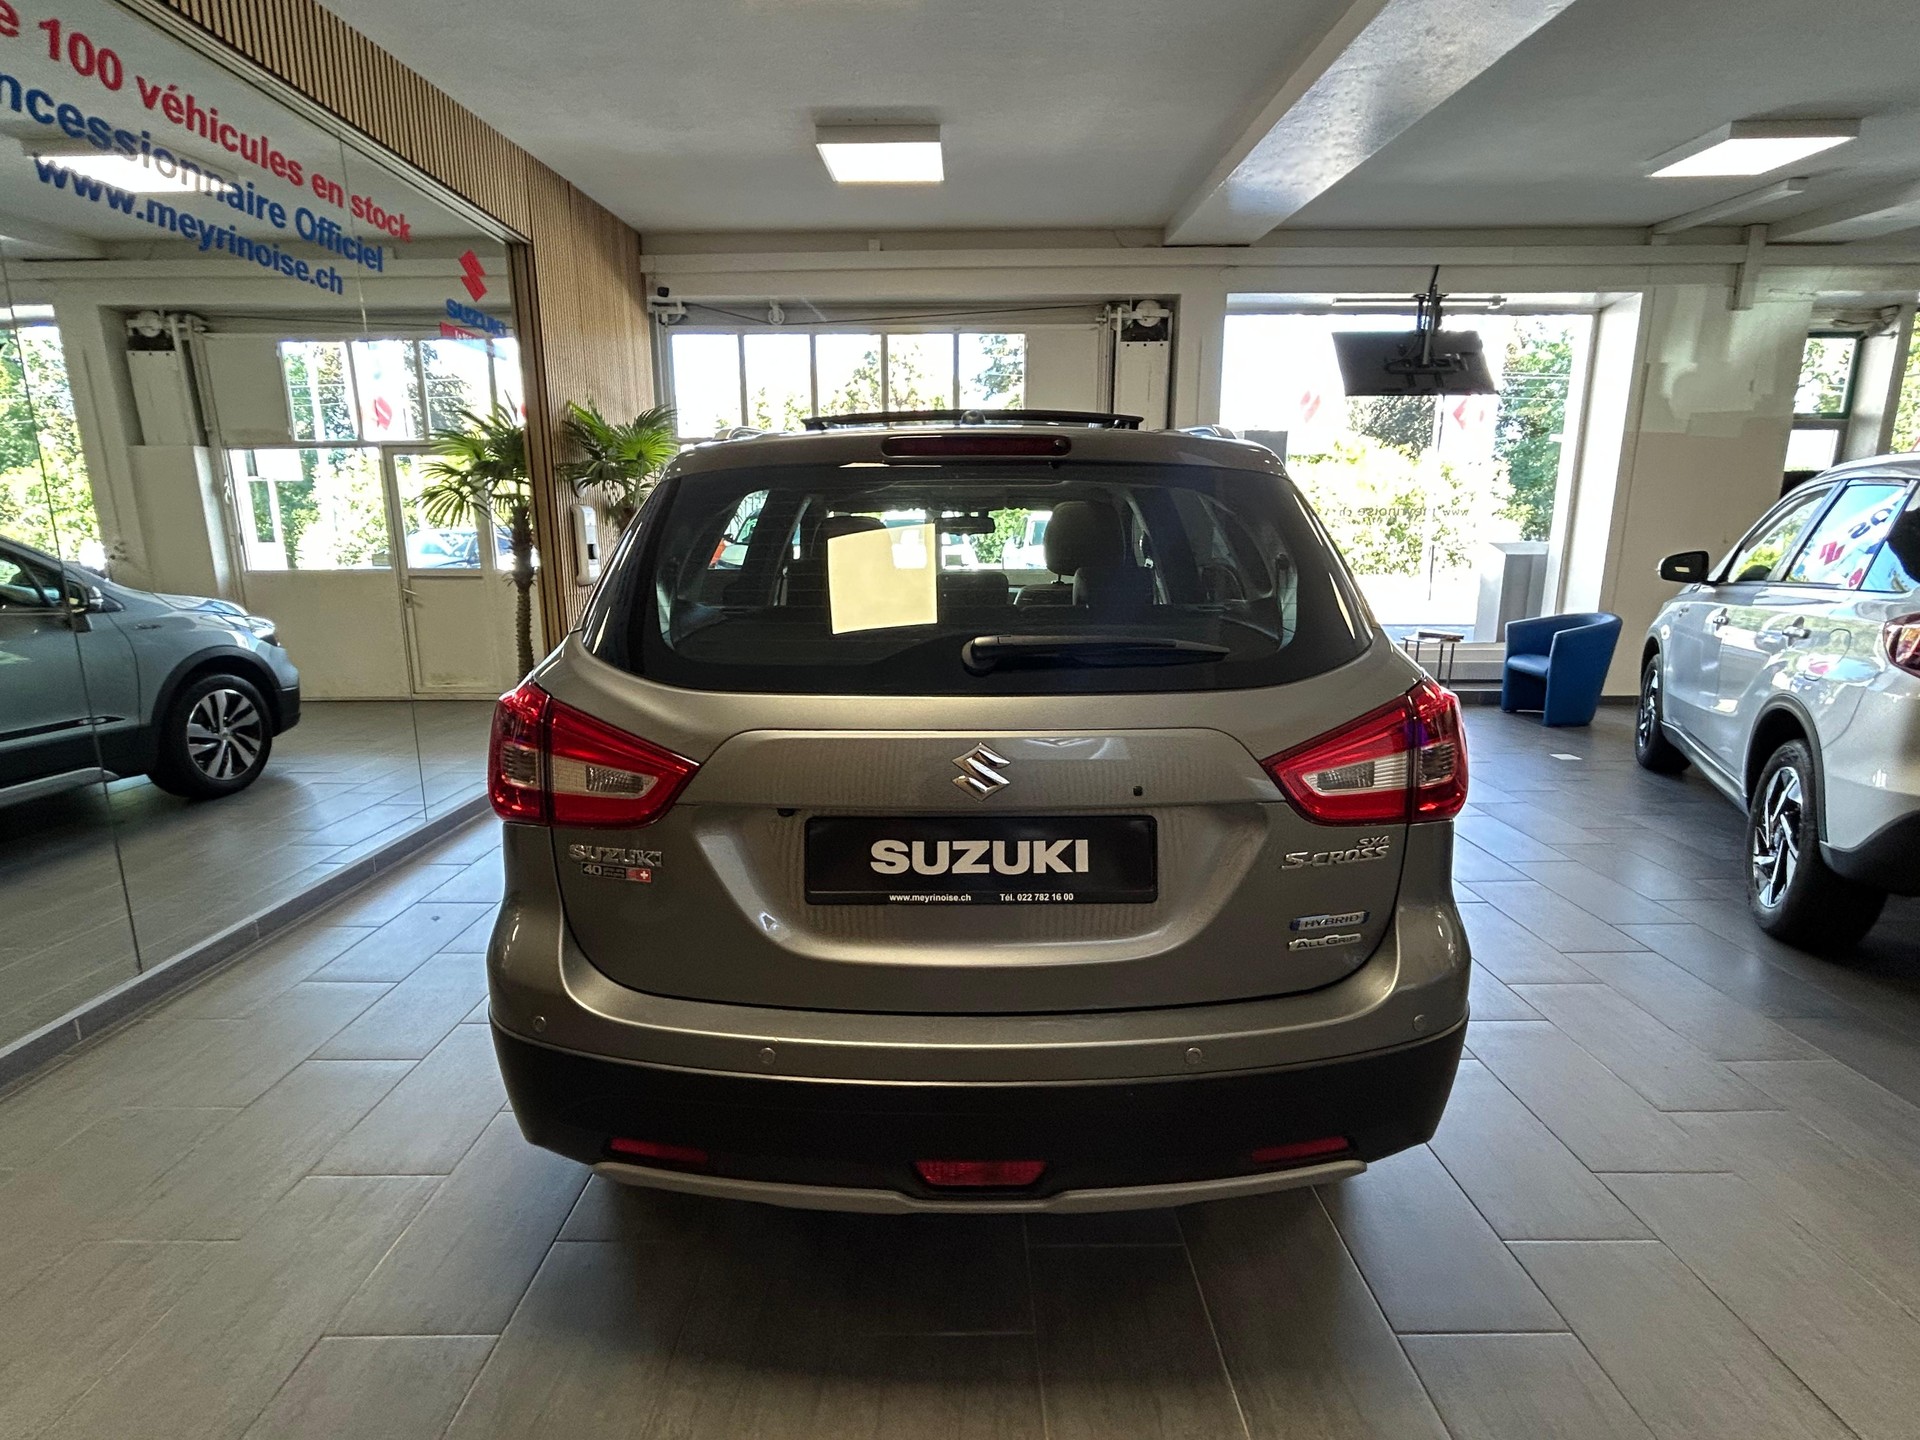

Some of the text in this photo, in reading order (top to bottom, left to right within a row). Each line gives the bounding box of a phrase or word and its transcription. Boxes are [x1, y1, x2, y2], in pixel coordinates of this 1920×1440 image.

[39, 18, 123, 91] 100
[136, 75, 304, 187] véhicules
[311, 173, 344, 208] en
[351, 194, 412, 243] stock
[0, 73, 384, 272] ncessionnaire Officiel
[33, 152, 343, 294] www.meyrinoise.ch
[1356, 835, 1390, 848] SX4
[569, 844, 662, 867] SUZUKI
[870, 839, 1089, 875] SUZUKI
[1281, 846, 1389, 869] S-CROSS
[583, 864, 602, 875] 40
[889, 892, 1074, 903] www.meyrinoise.ch Tél. 022 782 16 00
[1304, 914, 1360, 928] HYBRID
